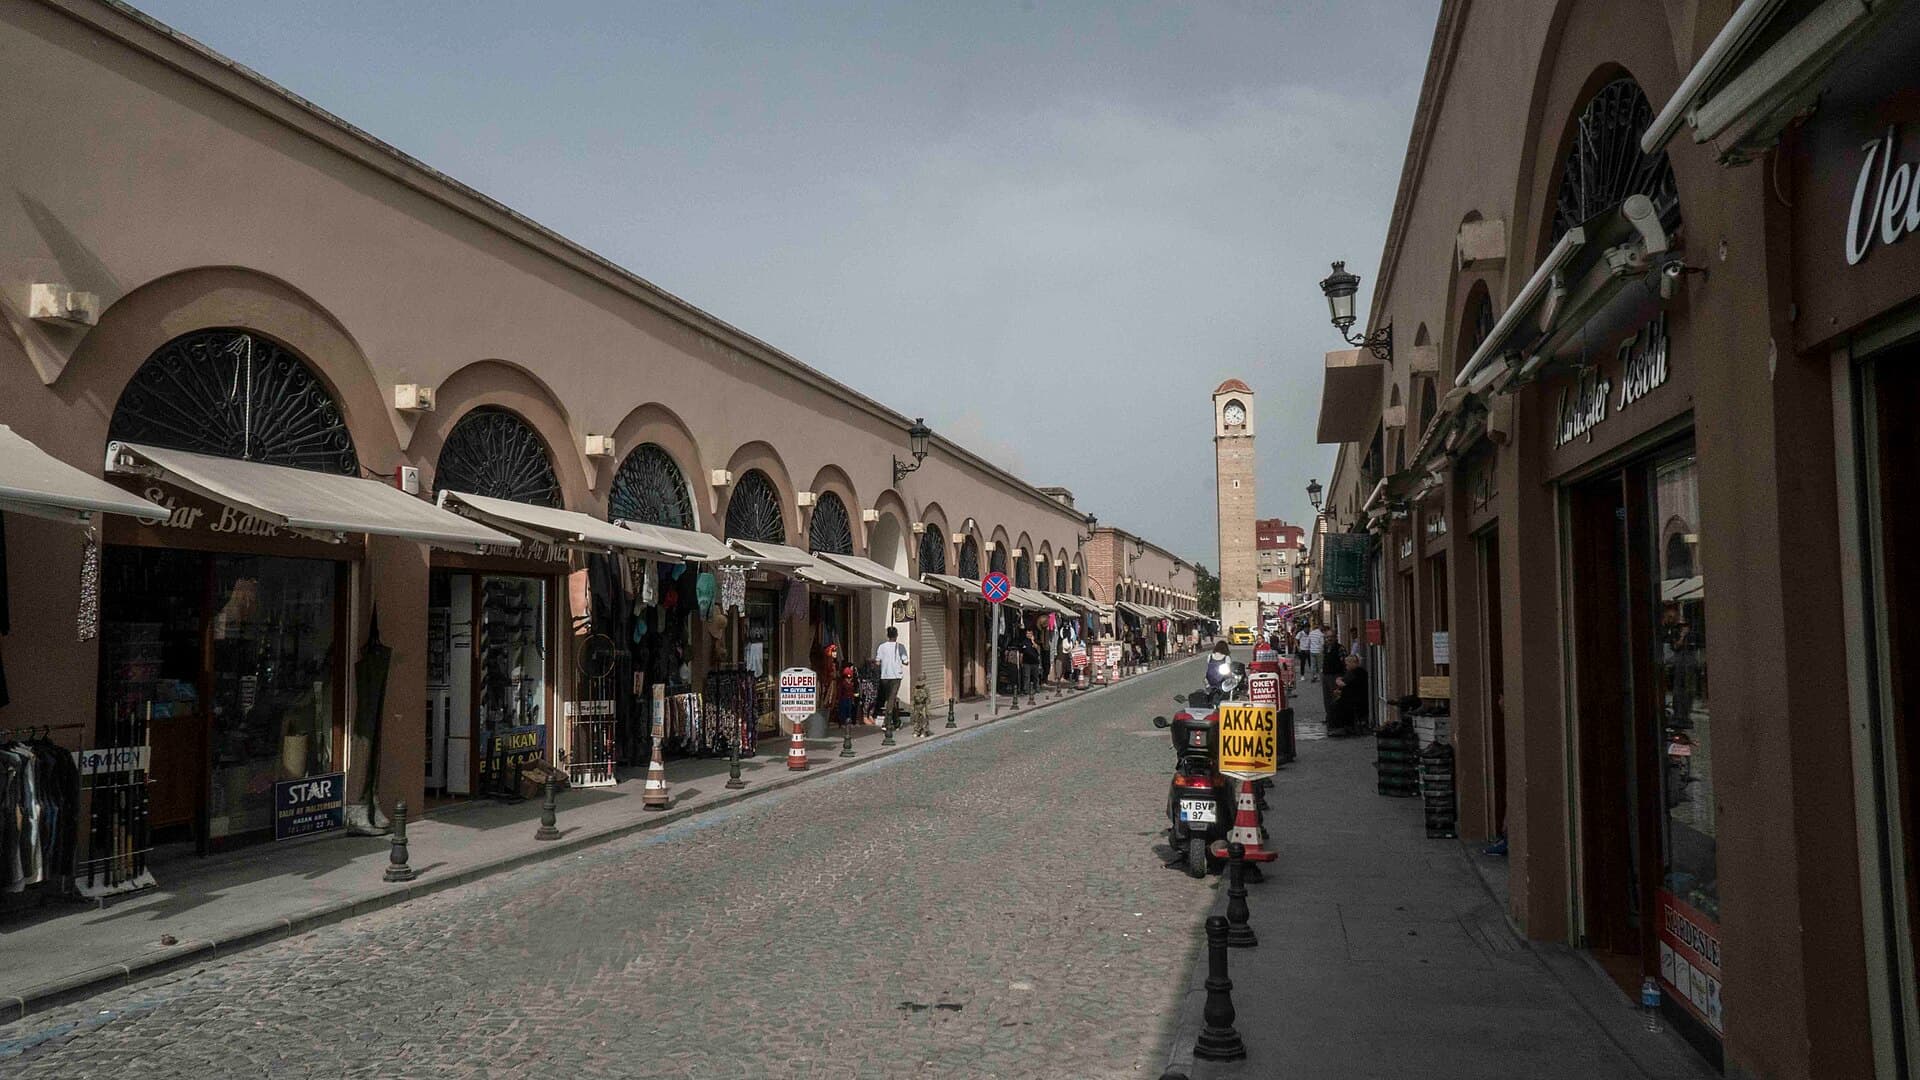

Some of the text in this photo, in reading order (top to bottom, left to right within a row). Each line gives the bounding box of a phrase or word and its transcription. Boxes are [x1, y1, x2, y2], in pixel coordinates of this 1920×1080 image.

[782, 674, 815, 685] GÜLPERİ
[1252, 680, 1275, 688] OKEY
[1222, 709, 1274, 735] AKKAŞ
[1222, 735, 1274, 762] KUMAŞ
[288, 780, 332, 804] STAR
